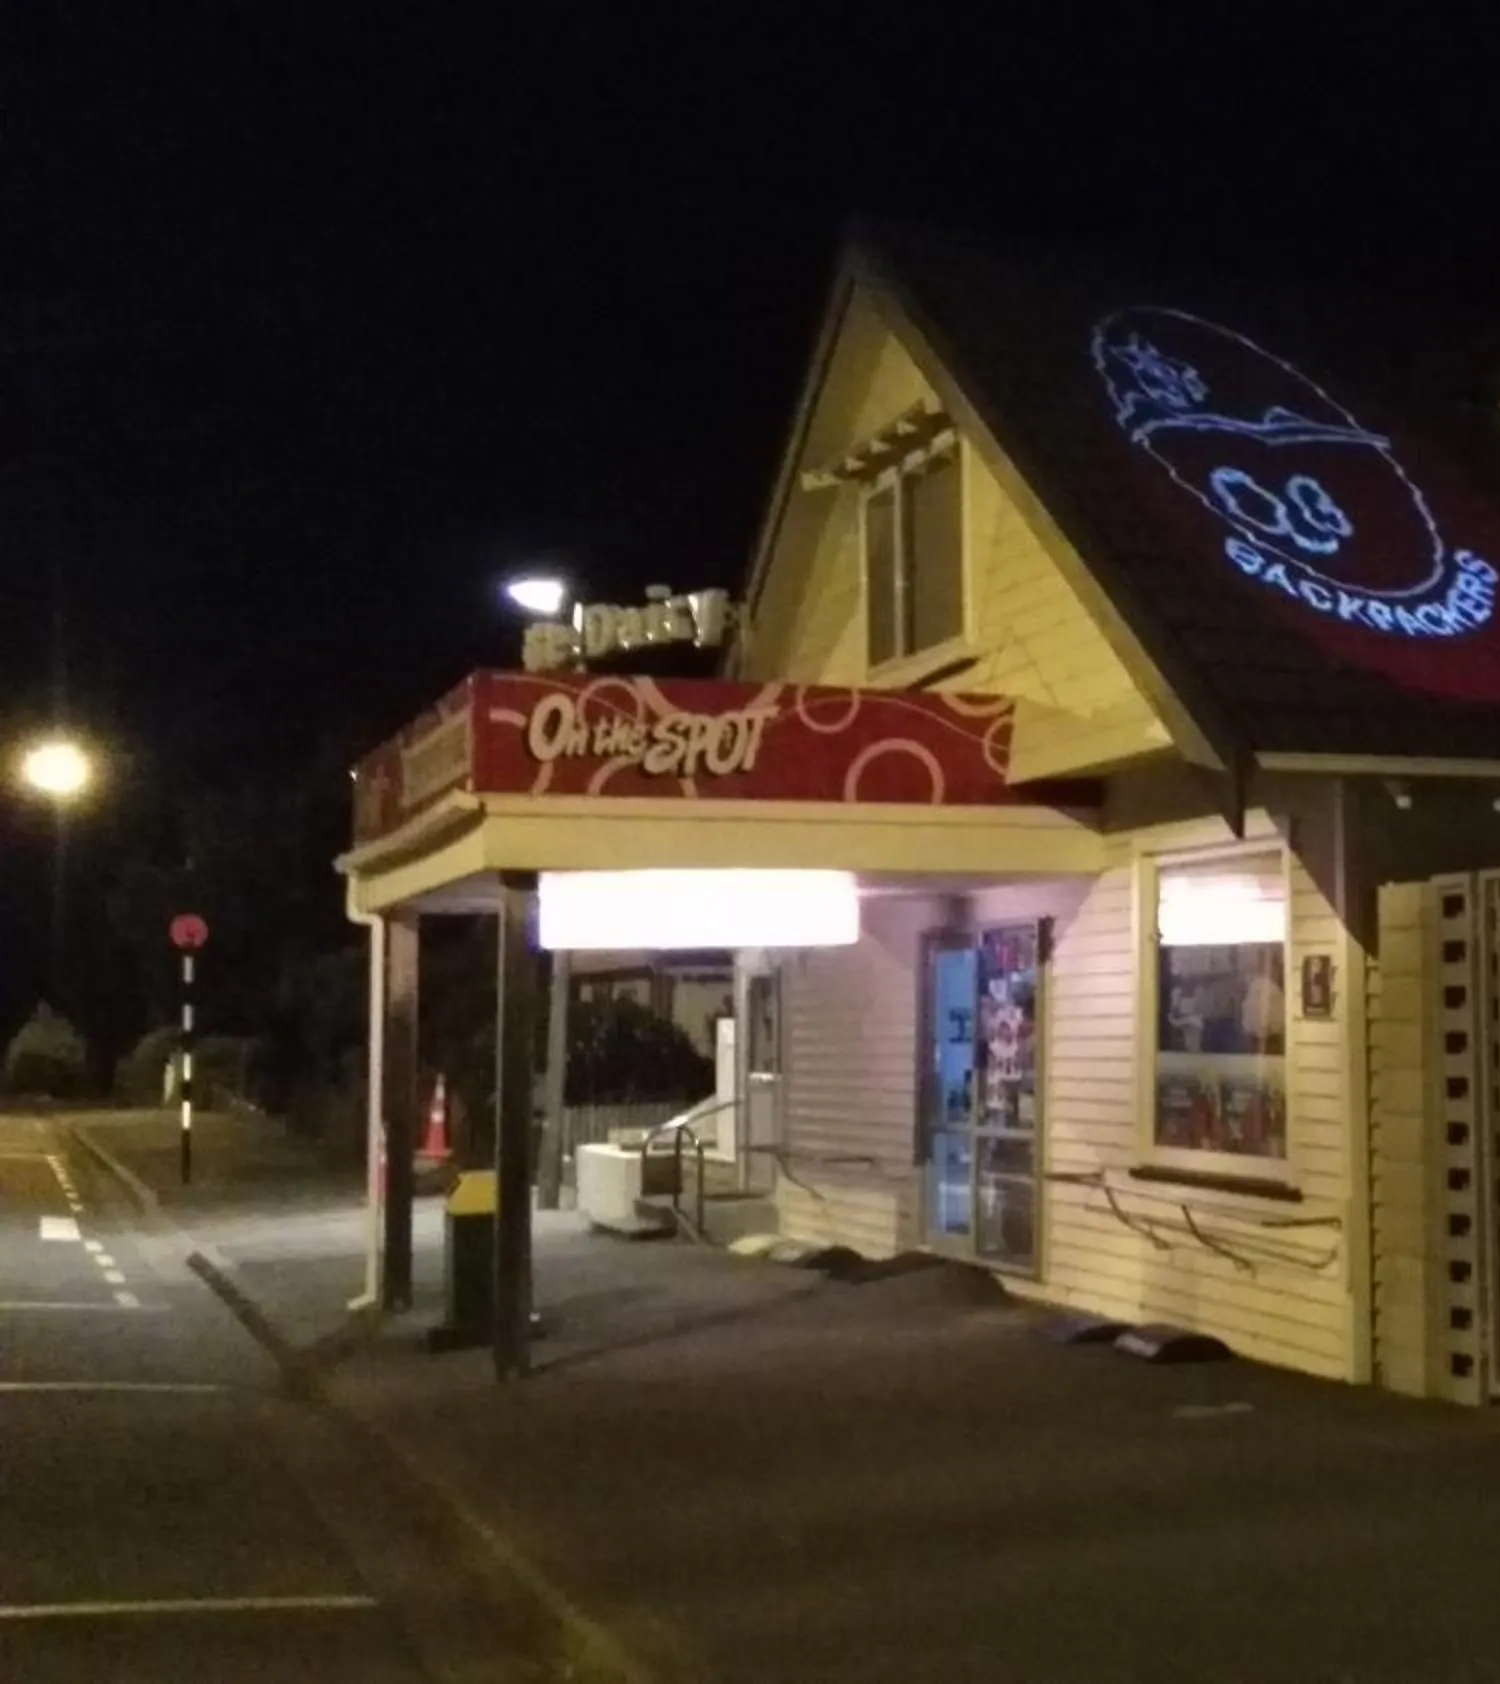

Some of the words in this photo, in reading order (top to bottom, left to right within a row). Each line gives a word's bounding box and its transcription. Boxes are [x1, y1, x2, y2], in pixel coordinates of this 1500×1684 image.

[1225, 537, 1499, 636] BACKPACKERS
[528, 692, 588, 762] On
[592, 714, 646, 757] the
[643, 704, 780, 774] SPOT
